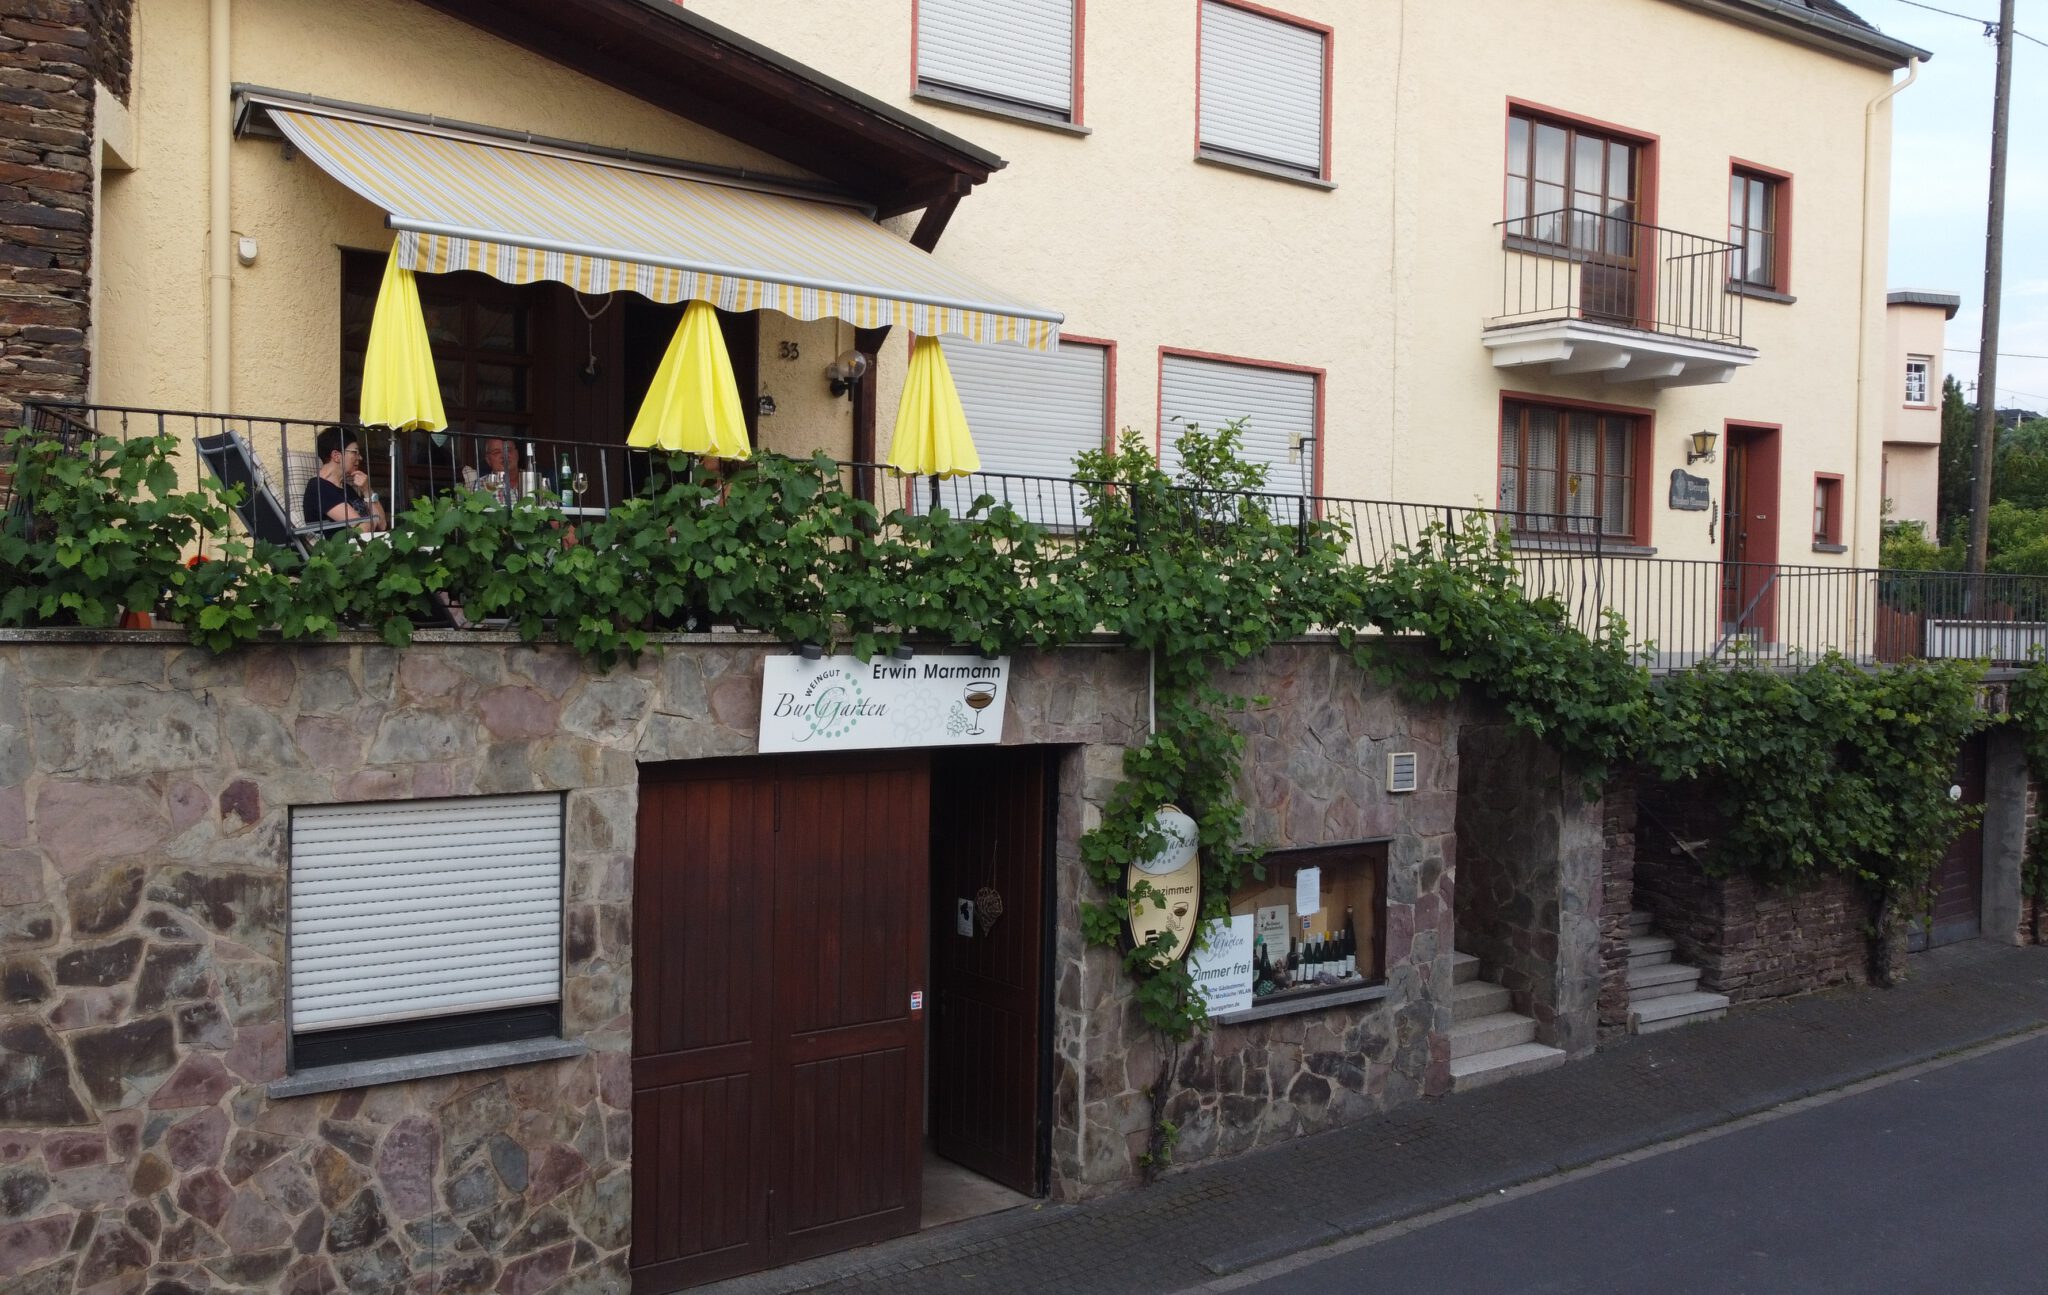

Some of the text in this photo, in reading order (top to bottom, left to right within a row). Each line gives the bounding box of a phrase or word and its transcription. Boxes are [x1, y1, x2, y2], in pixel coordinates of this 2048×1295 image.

[780, 340, 799, 360] 33
[872, 663, 1001, 680] Erwin Marmann
[804, 669, 841, 698] WEINGUT
[1192, 960, 1251, 982] Zimmer frei
